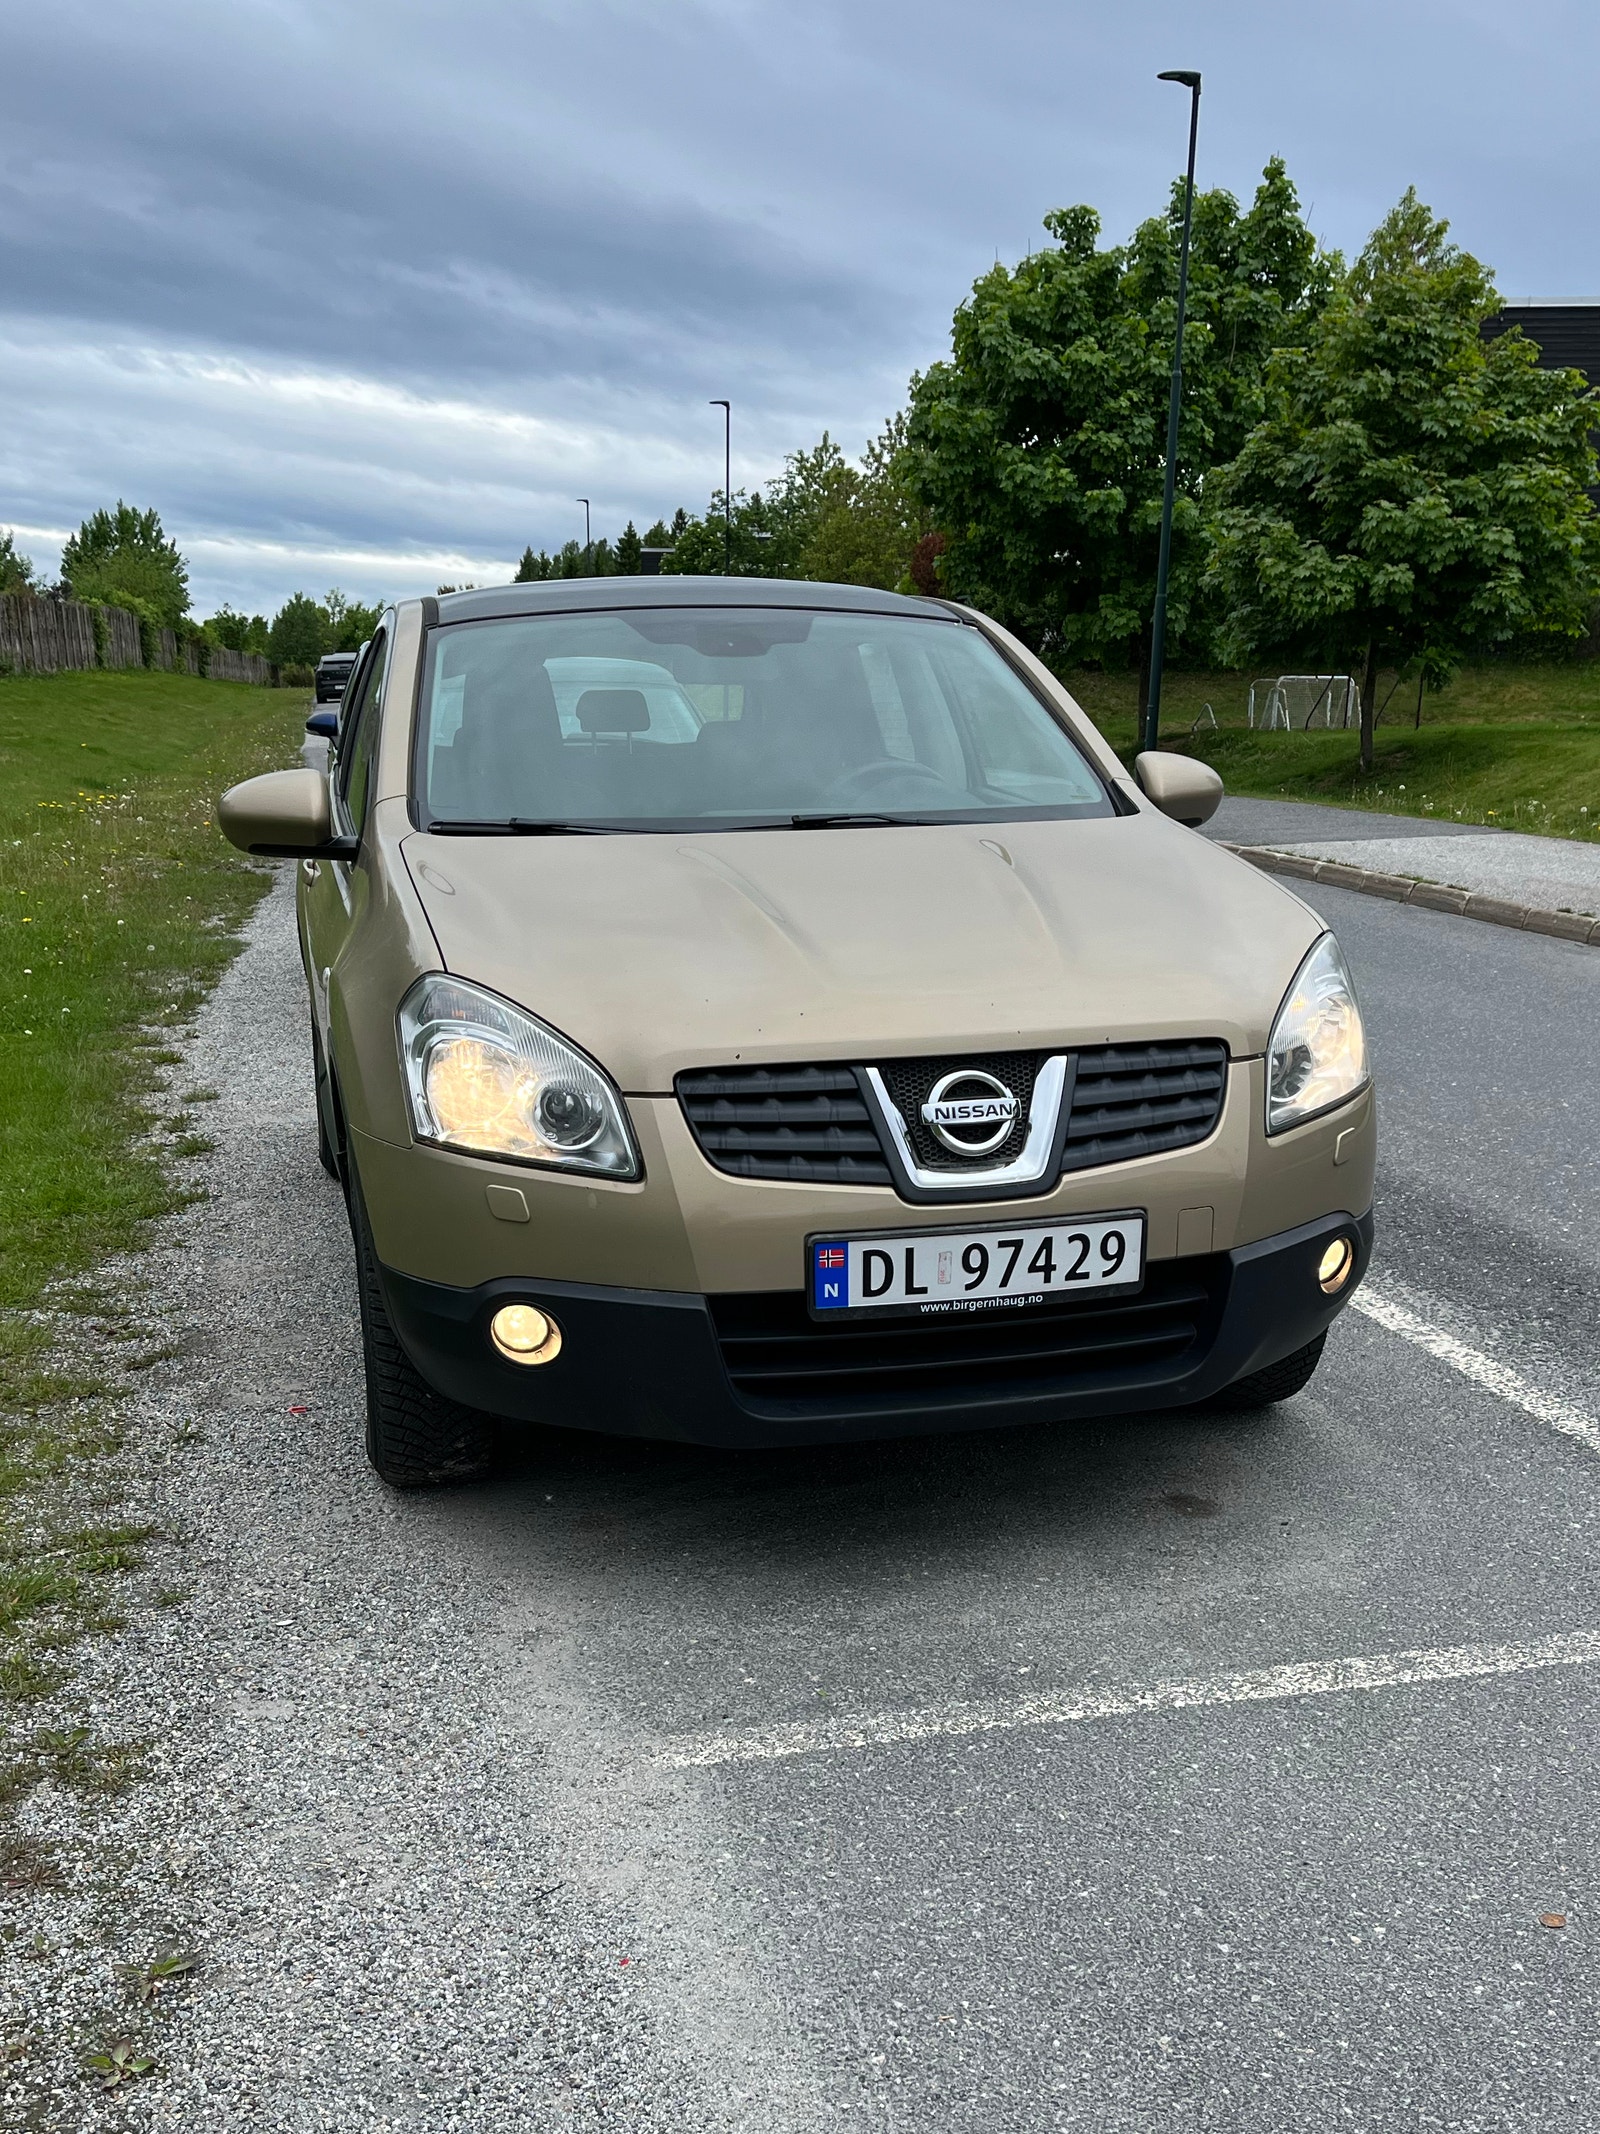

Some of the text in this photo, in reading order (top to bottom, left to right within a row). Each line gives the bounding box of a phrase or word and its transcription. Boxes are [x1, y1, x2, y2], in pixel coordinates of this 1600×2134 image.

[934, 1103, 1013, 1120] NISSAN
[861, 1229, 1126, 1298] DL 97429
[824, 1284, 839, 1298] N
[920, 1294, 1043, 1313] www.birgernhaug.no
